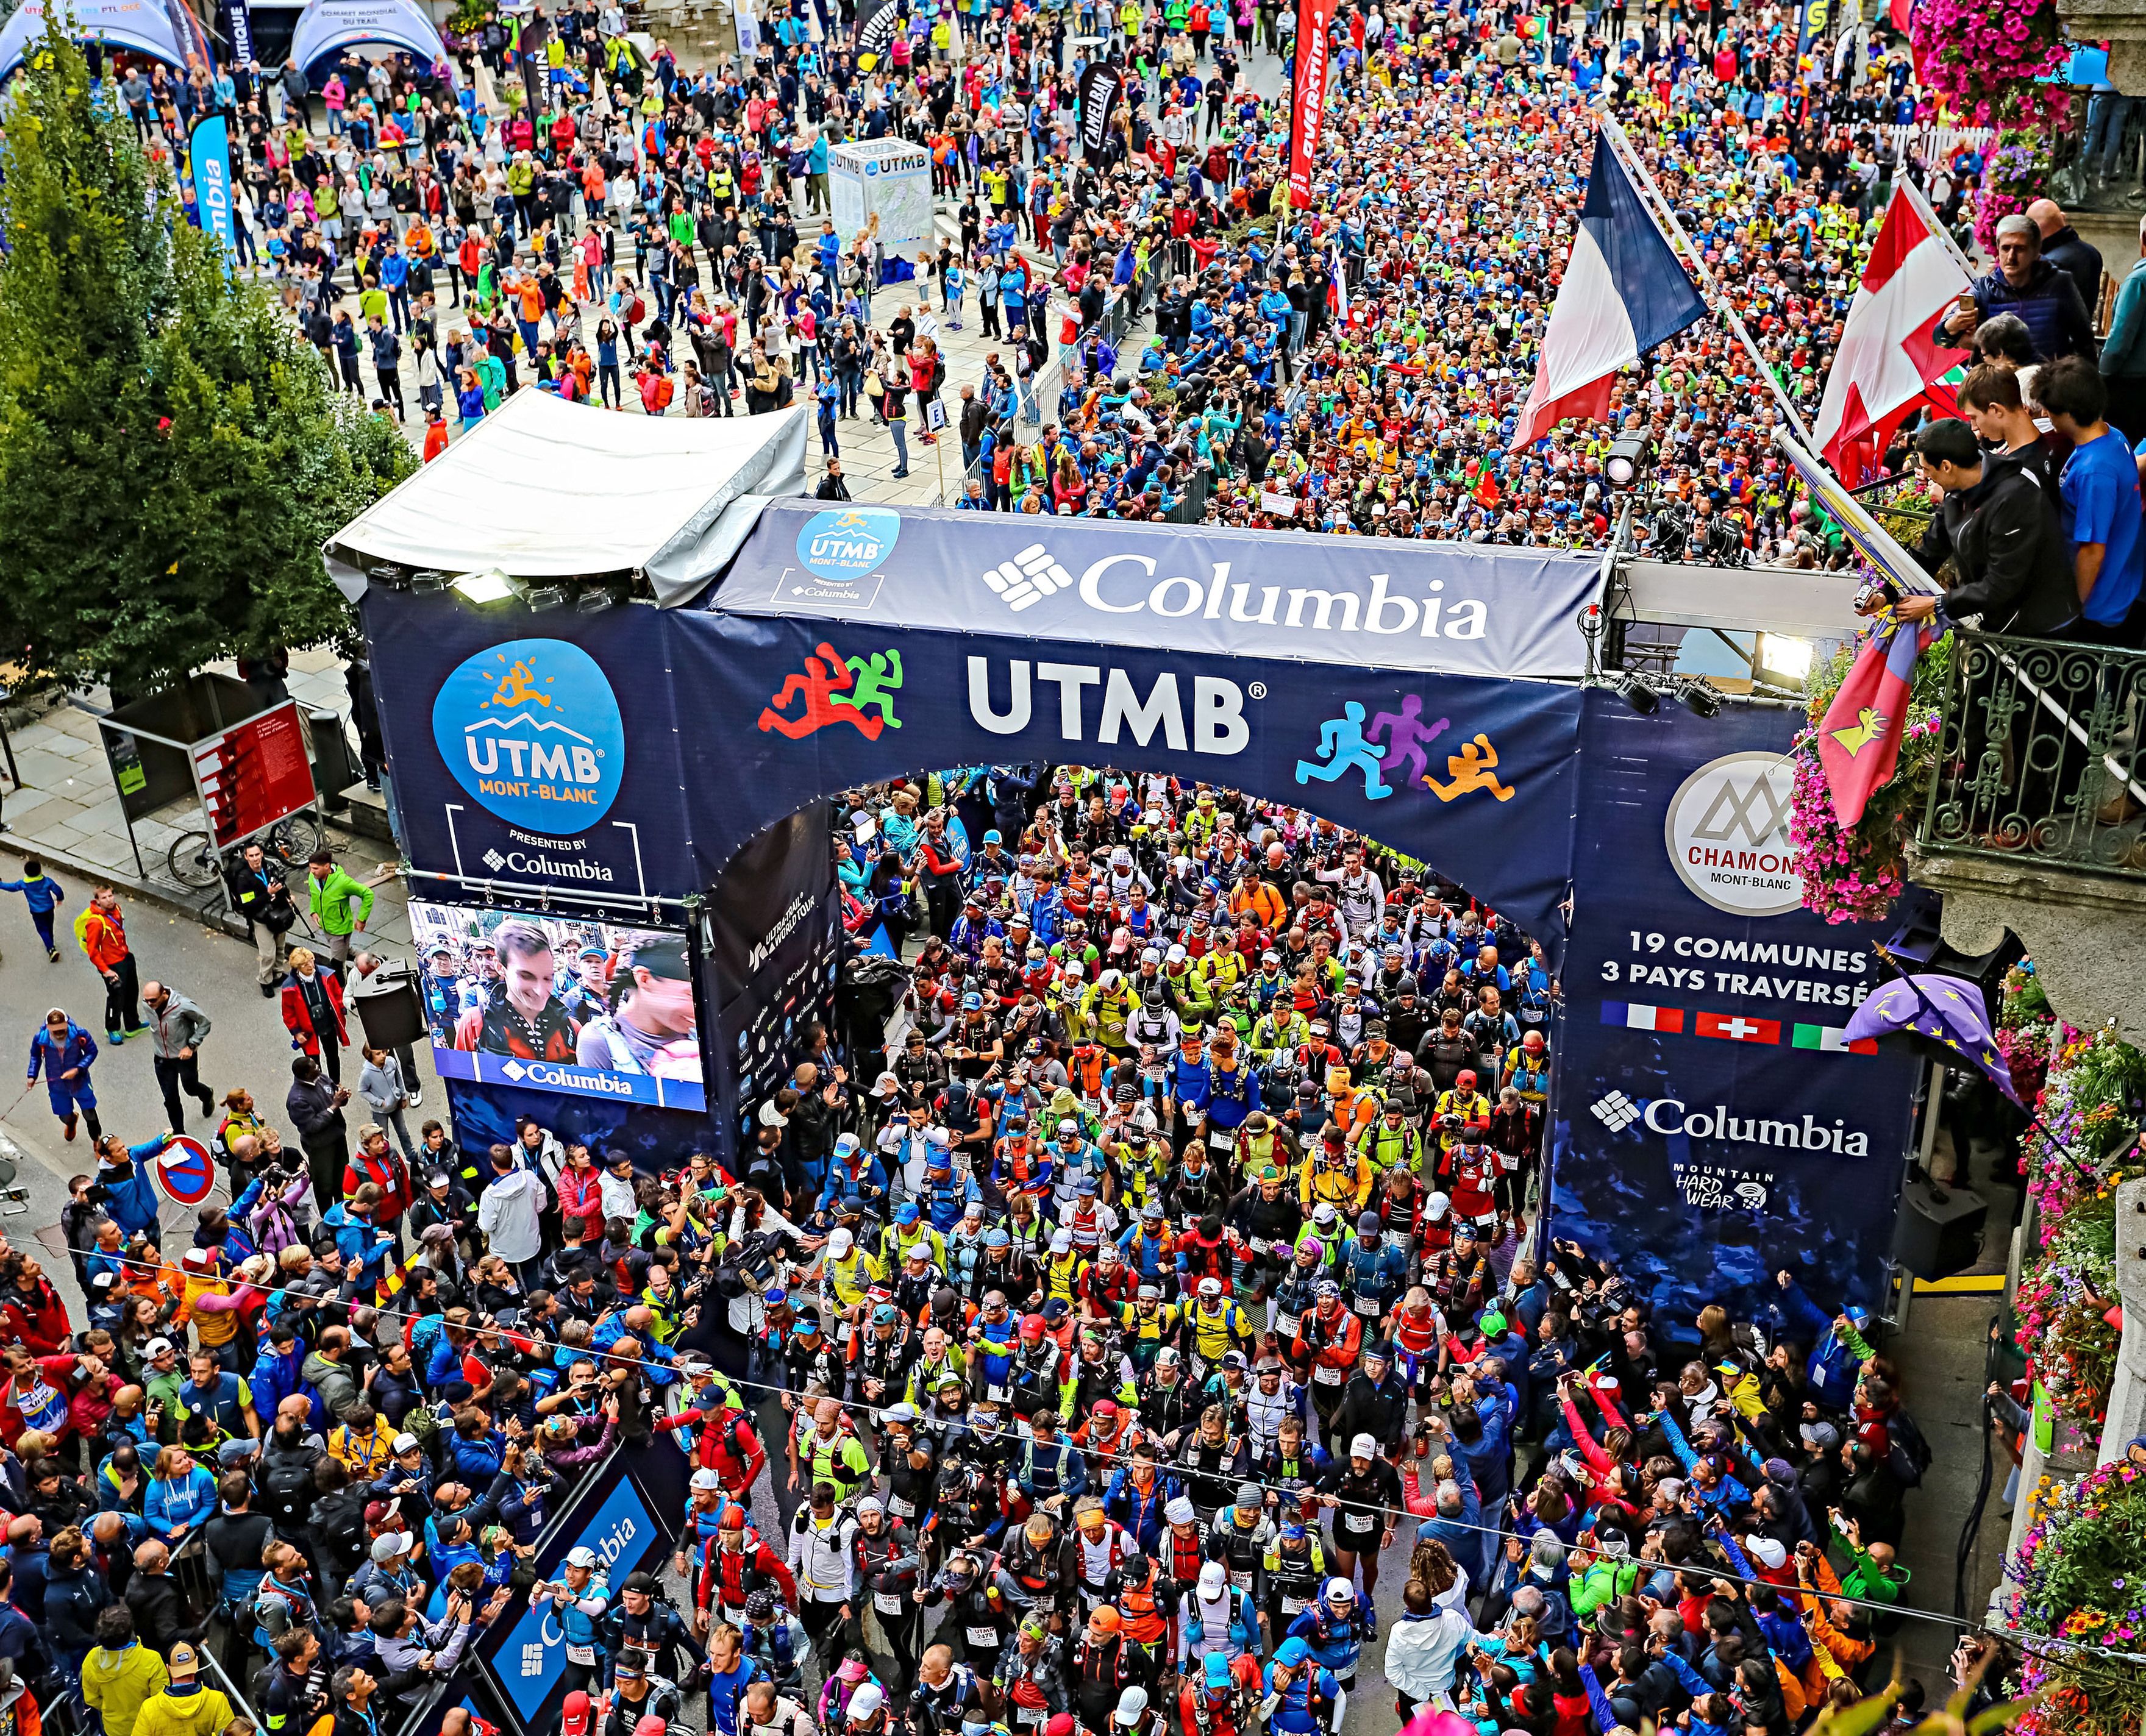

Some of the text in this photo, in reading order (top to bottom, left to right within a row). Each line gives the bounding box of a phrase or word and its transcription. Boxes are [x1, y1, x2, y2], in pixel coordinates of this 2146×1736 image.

[1084, 73, 1118, 149] CAMELBAK
[836, 154, 860, 174] UTMB
[880, 154, 926, 173] UTMB
[933, 408, 939, 423] E
[809, 557, 872, 569] MONT-BLANC
[804, 586, 860, 600] Columbia
[813, 578, 845, 588] PRESENTED
[1079, 553, 1488, 641] Columbia
[479, 778, 599, 805] MONT-BLANC
[509, 829, 587, 851] PRESENTED BY
[506, 851, 614, 882] Columbia
[1688, 845, 1797, 875] CHAMON
[1710, 872, 1791, 891] MONT-BLANC
[775, 895, 815, 947] WORLD TOUR
[1630, 931, 1867, 974] 19 COMMUNES
[1601, 961, 1868, 1007] 3 PAYS TRAVERSÉ
[526, 1062, 633, 1096] Columbia
[1644, 1098, 1869, 1157] Columbia
[1673, 1163, 1774, 1183] MOUNTAIN
[1675, 1175, 1724, 1195] HARD
[1686, 1189, 1734, 1211] WEAR
[1285, 1317, 1300, 1326] UTMB
[1285, 1323, 1298, 1331] 1810
[897, 1498, 915, 1507] UTMB
